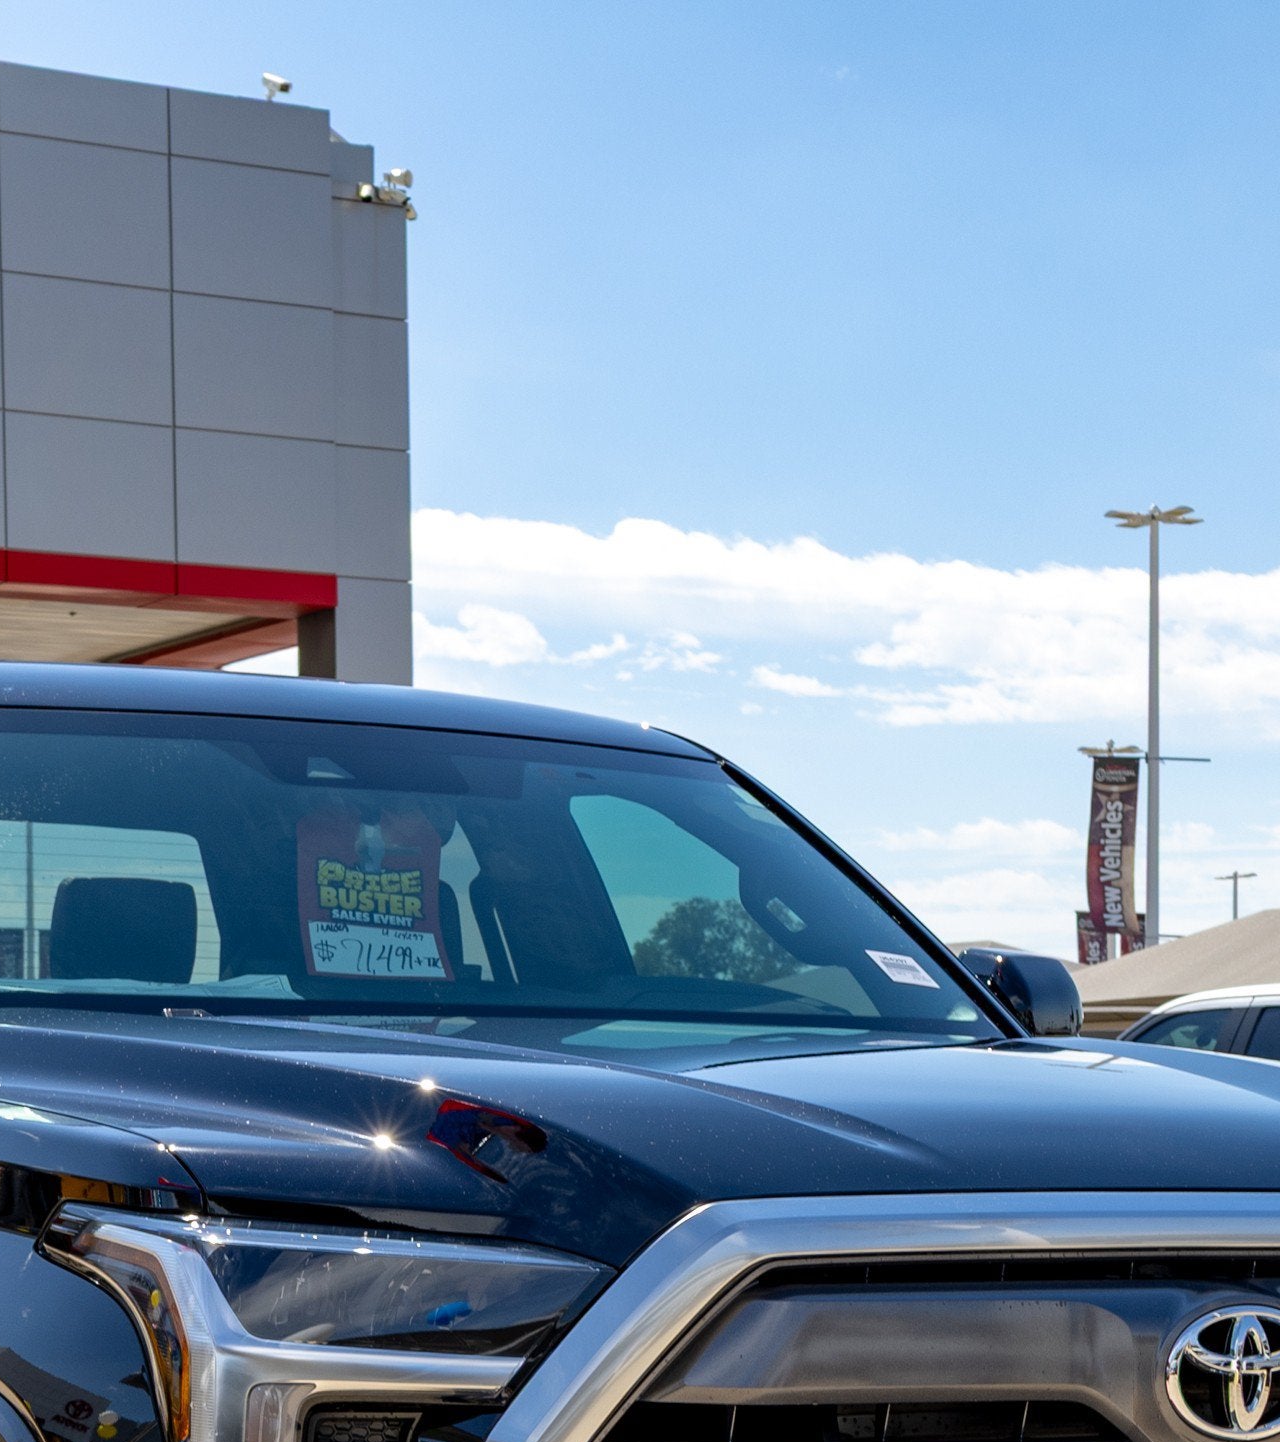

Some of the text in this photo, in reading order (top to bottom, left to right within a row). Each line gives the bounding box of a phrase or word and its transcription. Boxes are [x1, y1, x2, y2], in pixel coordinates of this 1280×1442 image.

[1100, 801, 1123, 882] Vehicles
[317, 859, 422, 894] PRICE
[320, 886, 423, 918] BUSTER
[332, 909, 412, 927] SALES EVENT
[1104, 887, 1125, 927] New
